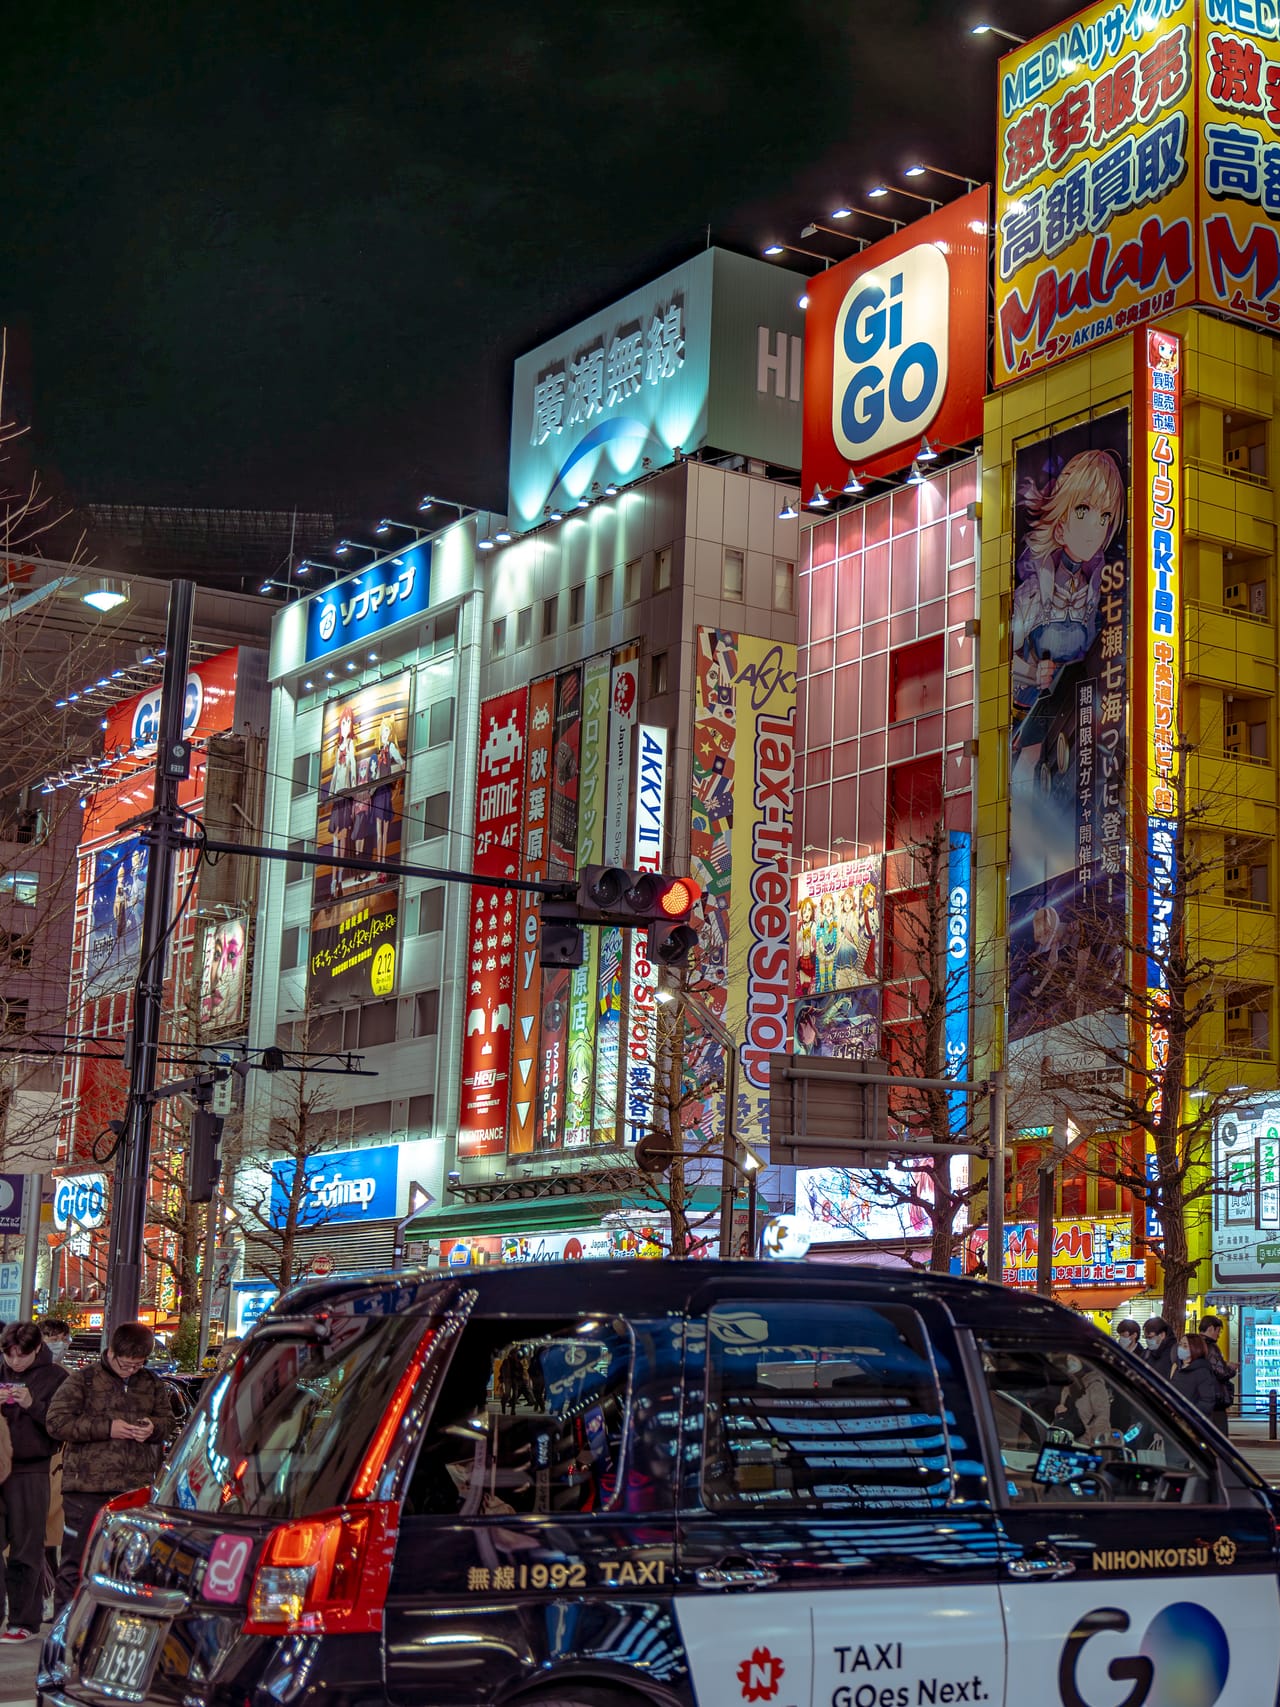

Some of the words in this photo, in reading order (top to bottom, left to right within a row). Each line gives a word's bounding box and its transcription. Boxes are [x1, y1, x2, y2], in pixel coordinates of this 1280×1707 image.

[1004, 31, 1187, 190] 激安販売
[1001, 113, 1187, 277] 高額買取
[999, 217, 1193, 372] Mulan
[843, 272, 903, 364] Gi
[841, 341, 938, 444] GO
[1153, 371, 1175, 390] 買取
[1153, 391, 1175, 411] 販売
[1153, 412, 1175, 433] 市場
[1152, 435, 1174, 531] ムーラン
[340, 566, 416, 626] ソフマップ
[1152, 529, 1175, 636] AKIBA
[480, 777, 519, 823] GAME
[580, 687, 600, 868] メロンブック
[640, 731, 664, 826] AKKY
[527, 747, 549, 863] 秋葉原
[615, 774, 626, 830] Tax-free
[751, 707, 797, 941] Tax-free
[476, 831, 492, 856] 2F
[501, 822, 518, 848] 4F
[612, 831, 624, 866] Shop
[638, 825, 661, 845] II
[949, 886, 968, 959] GiGO
[377, 952, 392, 976] 2.12
[743, 943, 791, 1090] Shop
[473, 1071, 498, 1089] Hey
[550, 1041, 560, 1087] MAD
[629, 1067, 652, 1117] 愛客
[548, 1093, 559, 1143] CATZ
[57, 1181, 104, 1223] GiGO
[310, 1173, 376, 1211] Sofmap
[1235, 1208, 1247, 1216] BUY
[1093, 1263, 1137, 1281] ホビー館
[599, 1560, 666, 1585] TAXI
[1092, 1546, 1208, 1571] NIHONKOTSU
[833, 1642, 902, 1673] TAXI
[831, 1685, 910, 1707] GOes
[917, 1677, 989, 1707] Next.
